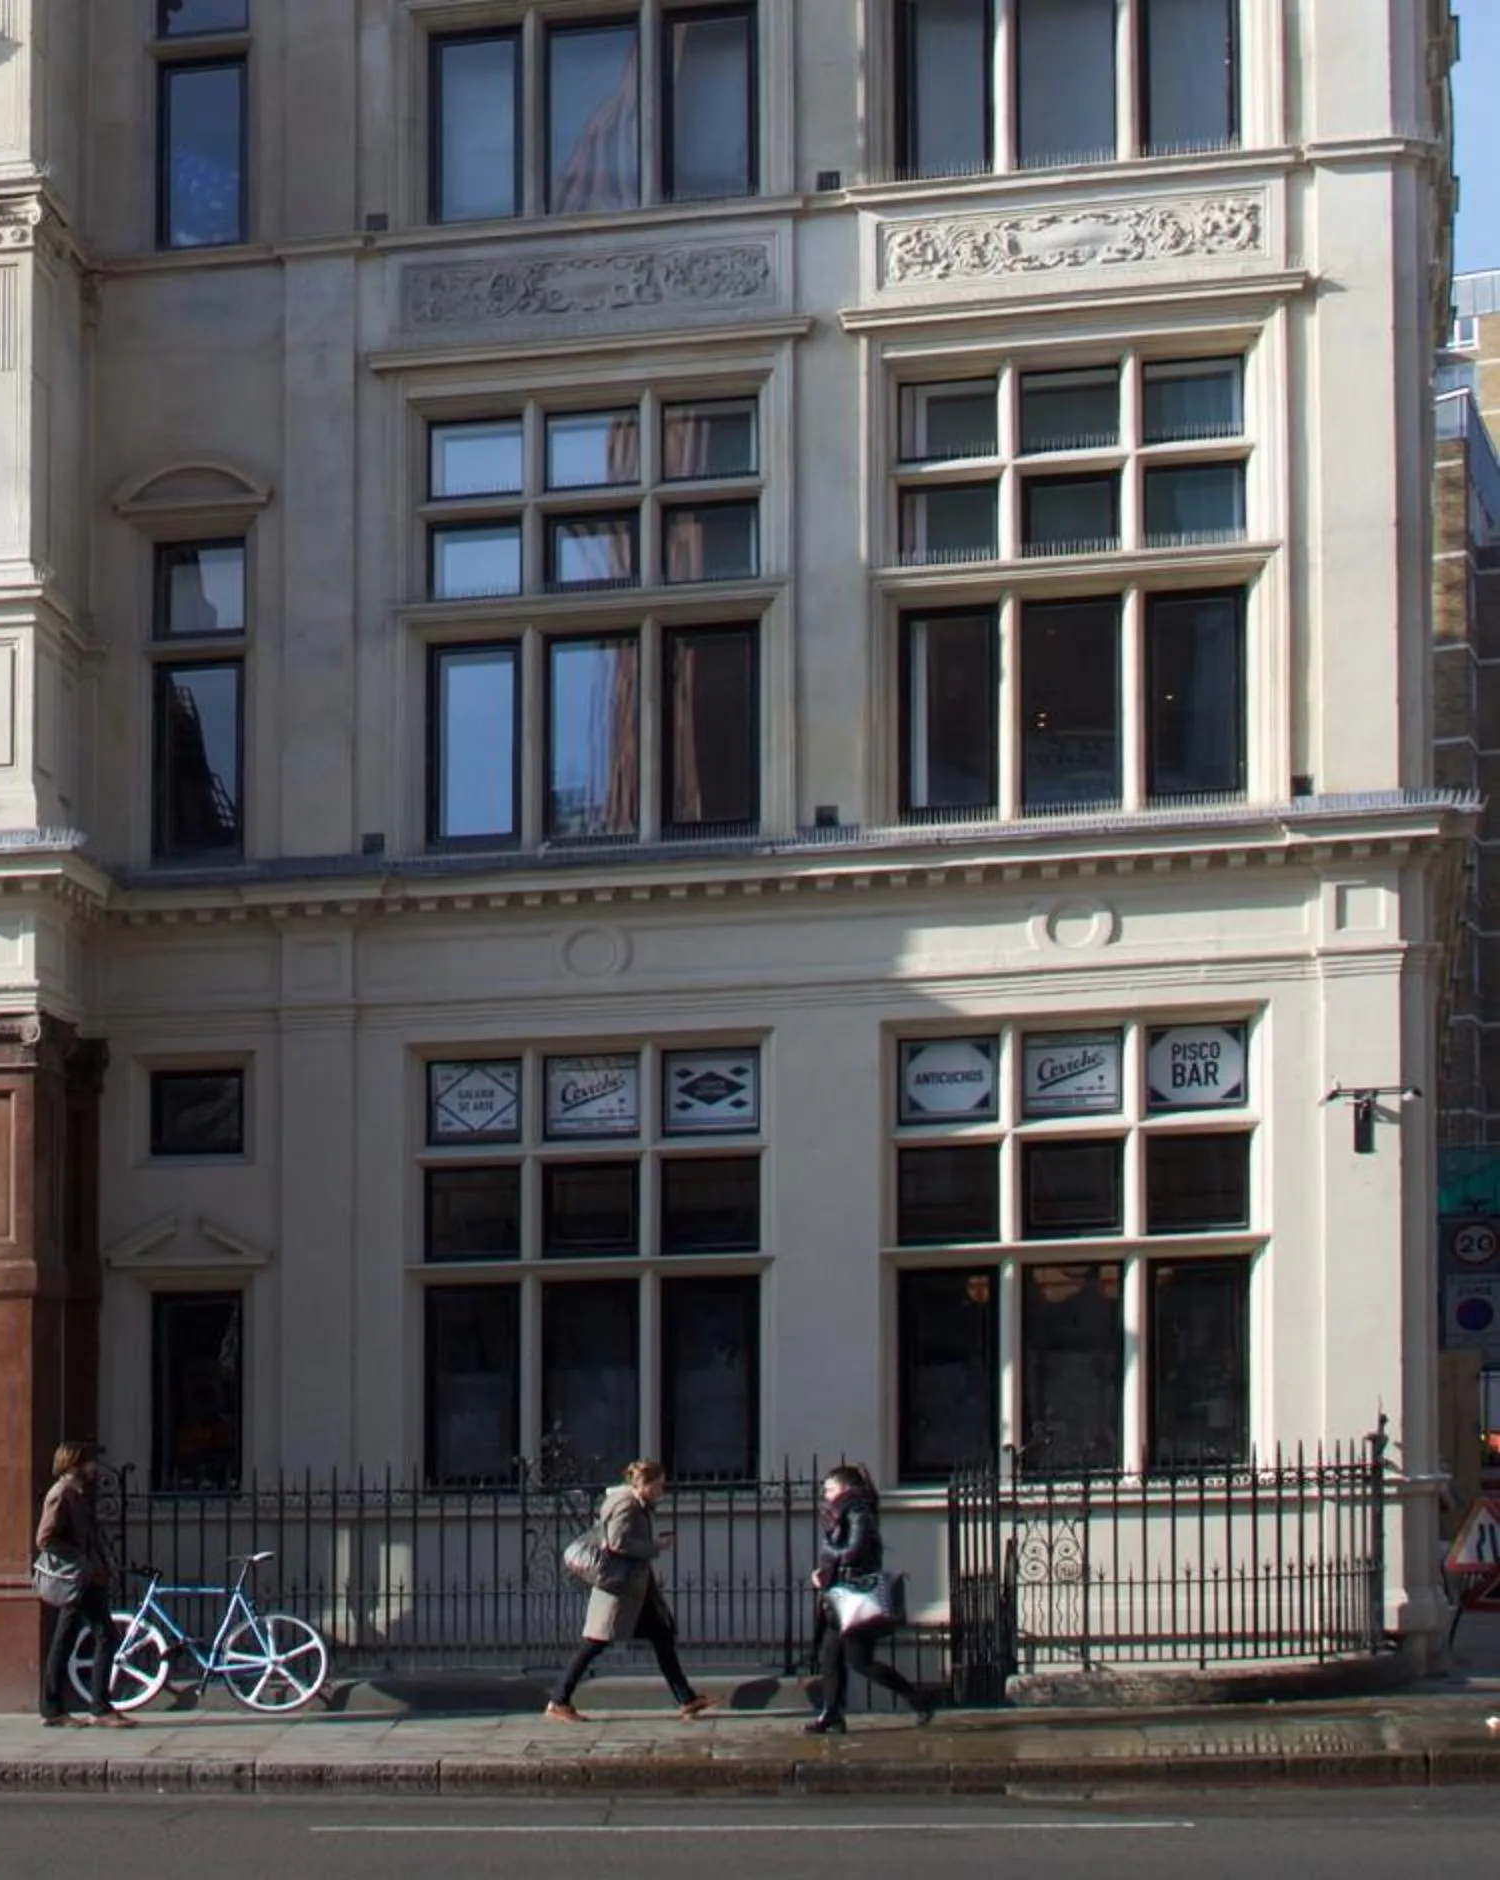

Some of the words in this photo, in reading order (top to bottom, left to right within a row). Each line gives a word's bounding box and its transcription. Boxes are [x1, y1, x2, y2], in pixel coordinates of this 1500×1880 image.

[1171, 1041, 1221, 1060] PISCO
[1171, 1061, 1219, 1089] BAR
[1459, 1233, 1494, 1254] 20
